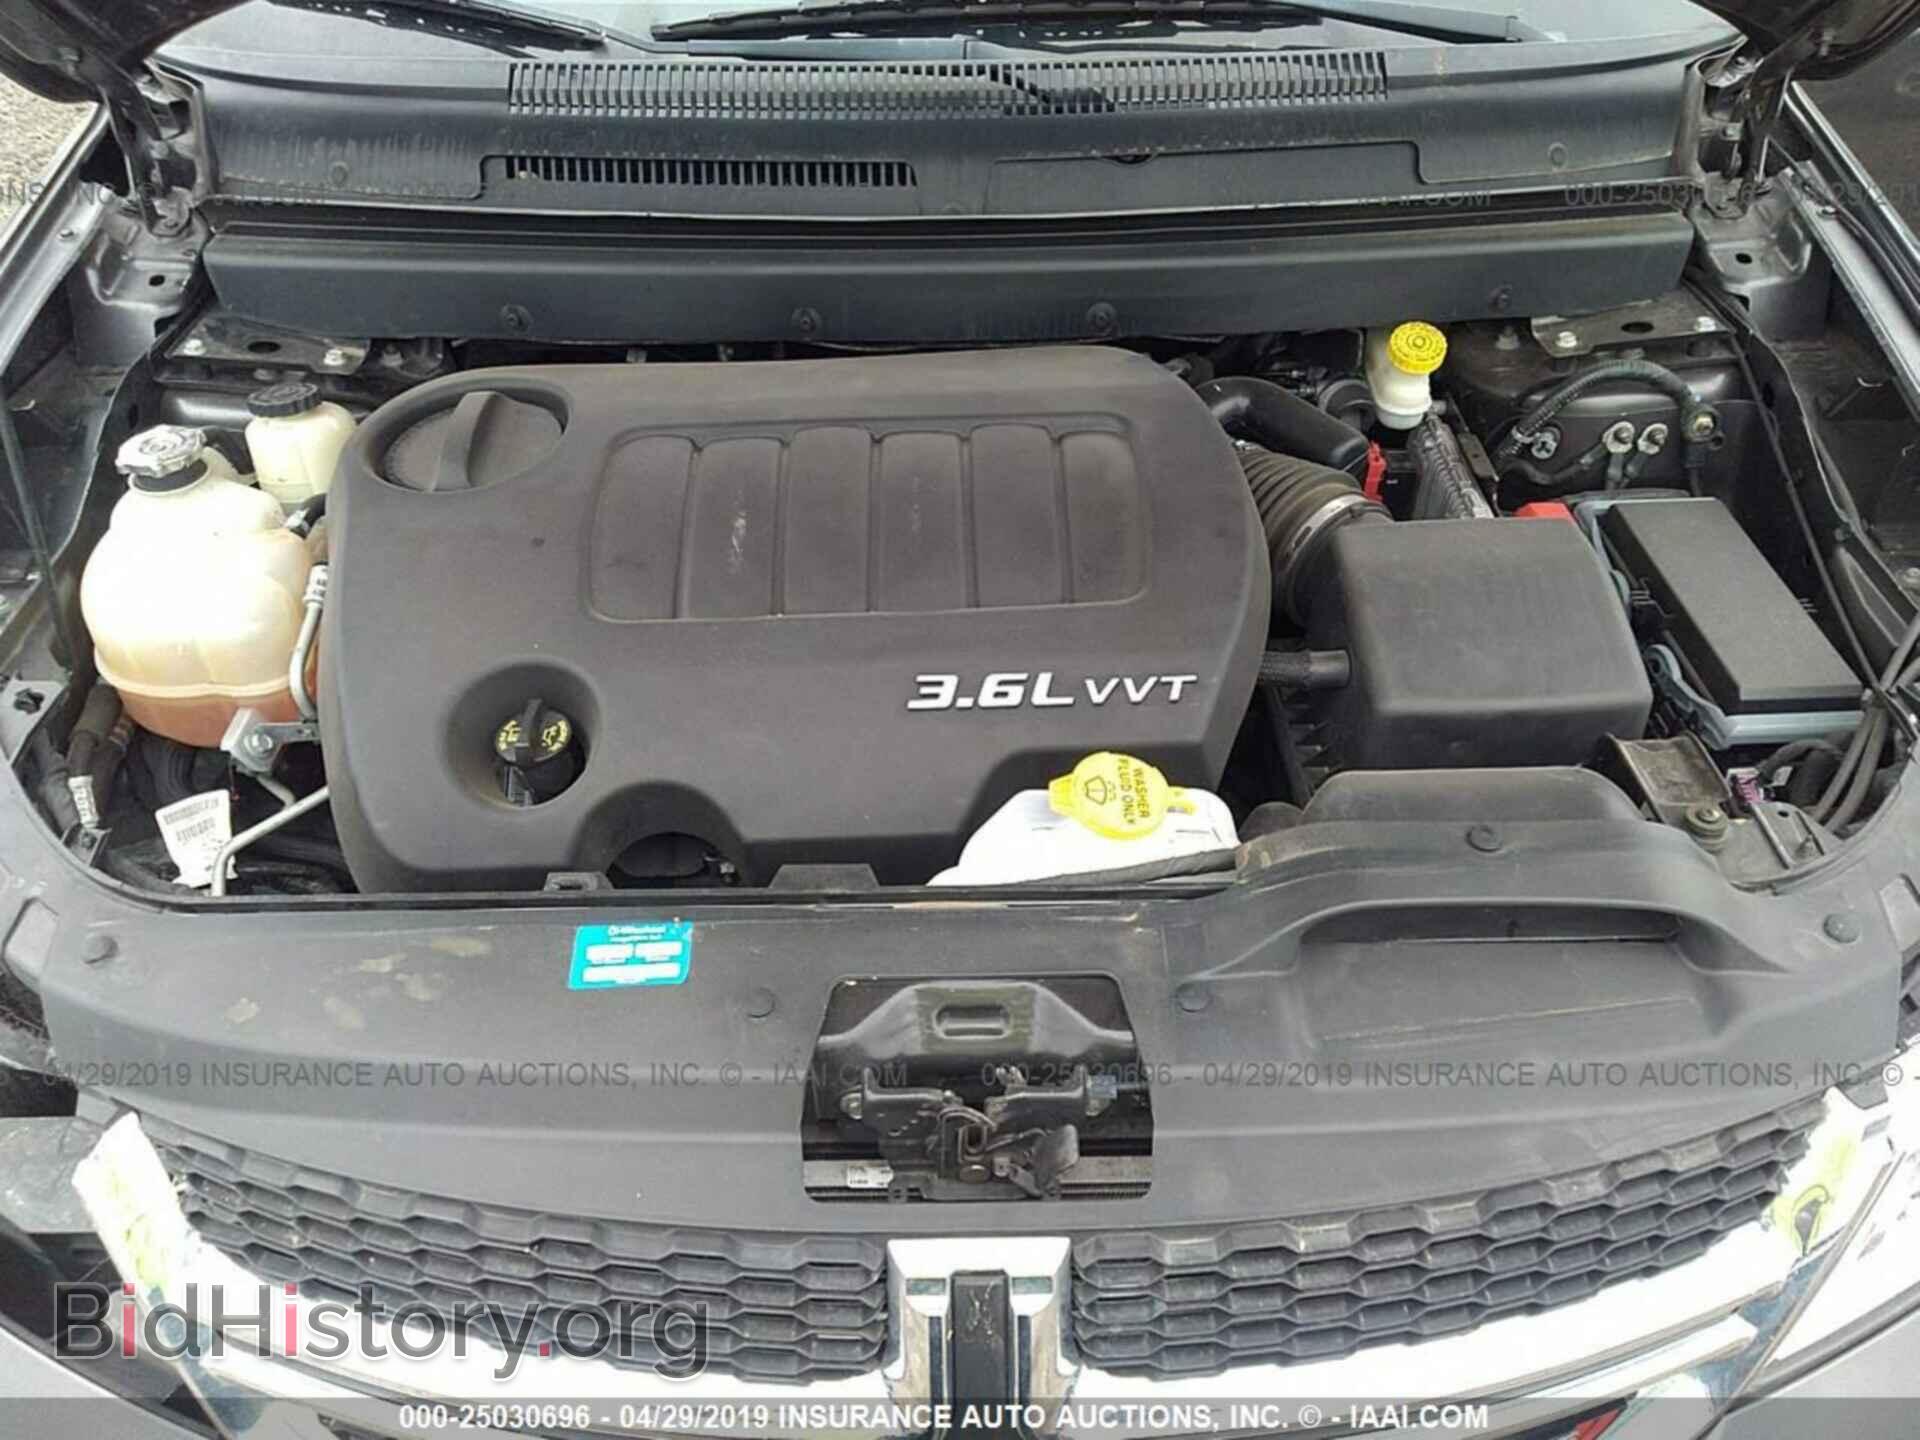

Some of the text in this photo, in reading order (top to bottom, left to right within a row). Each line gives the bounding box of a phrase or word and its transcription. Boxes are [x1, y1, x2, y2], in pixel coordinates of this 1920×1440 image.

[907, 672, 1198, 710] 3.6L VVT
[1117, 757, 1136, 825] FLUID ONLY
[1133, 767, 1151, 819] WASHER
